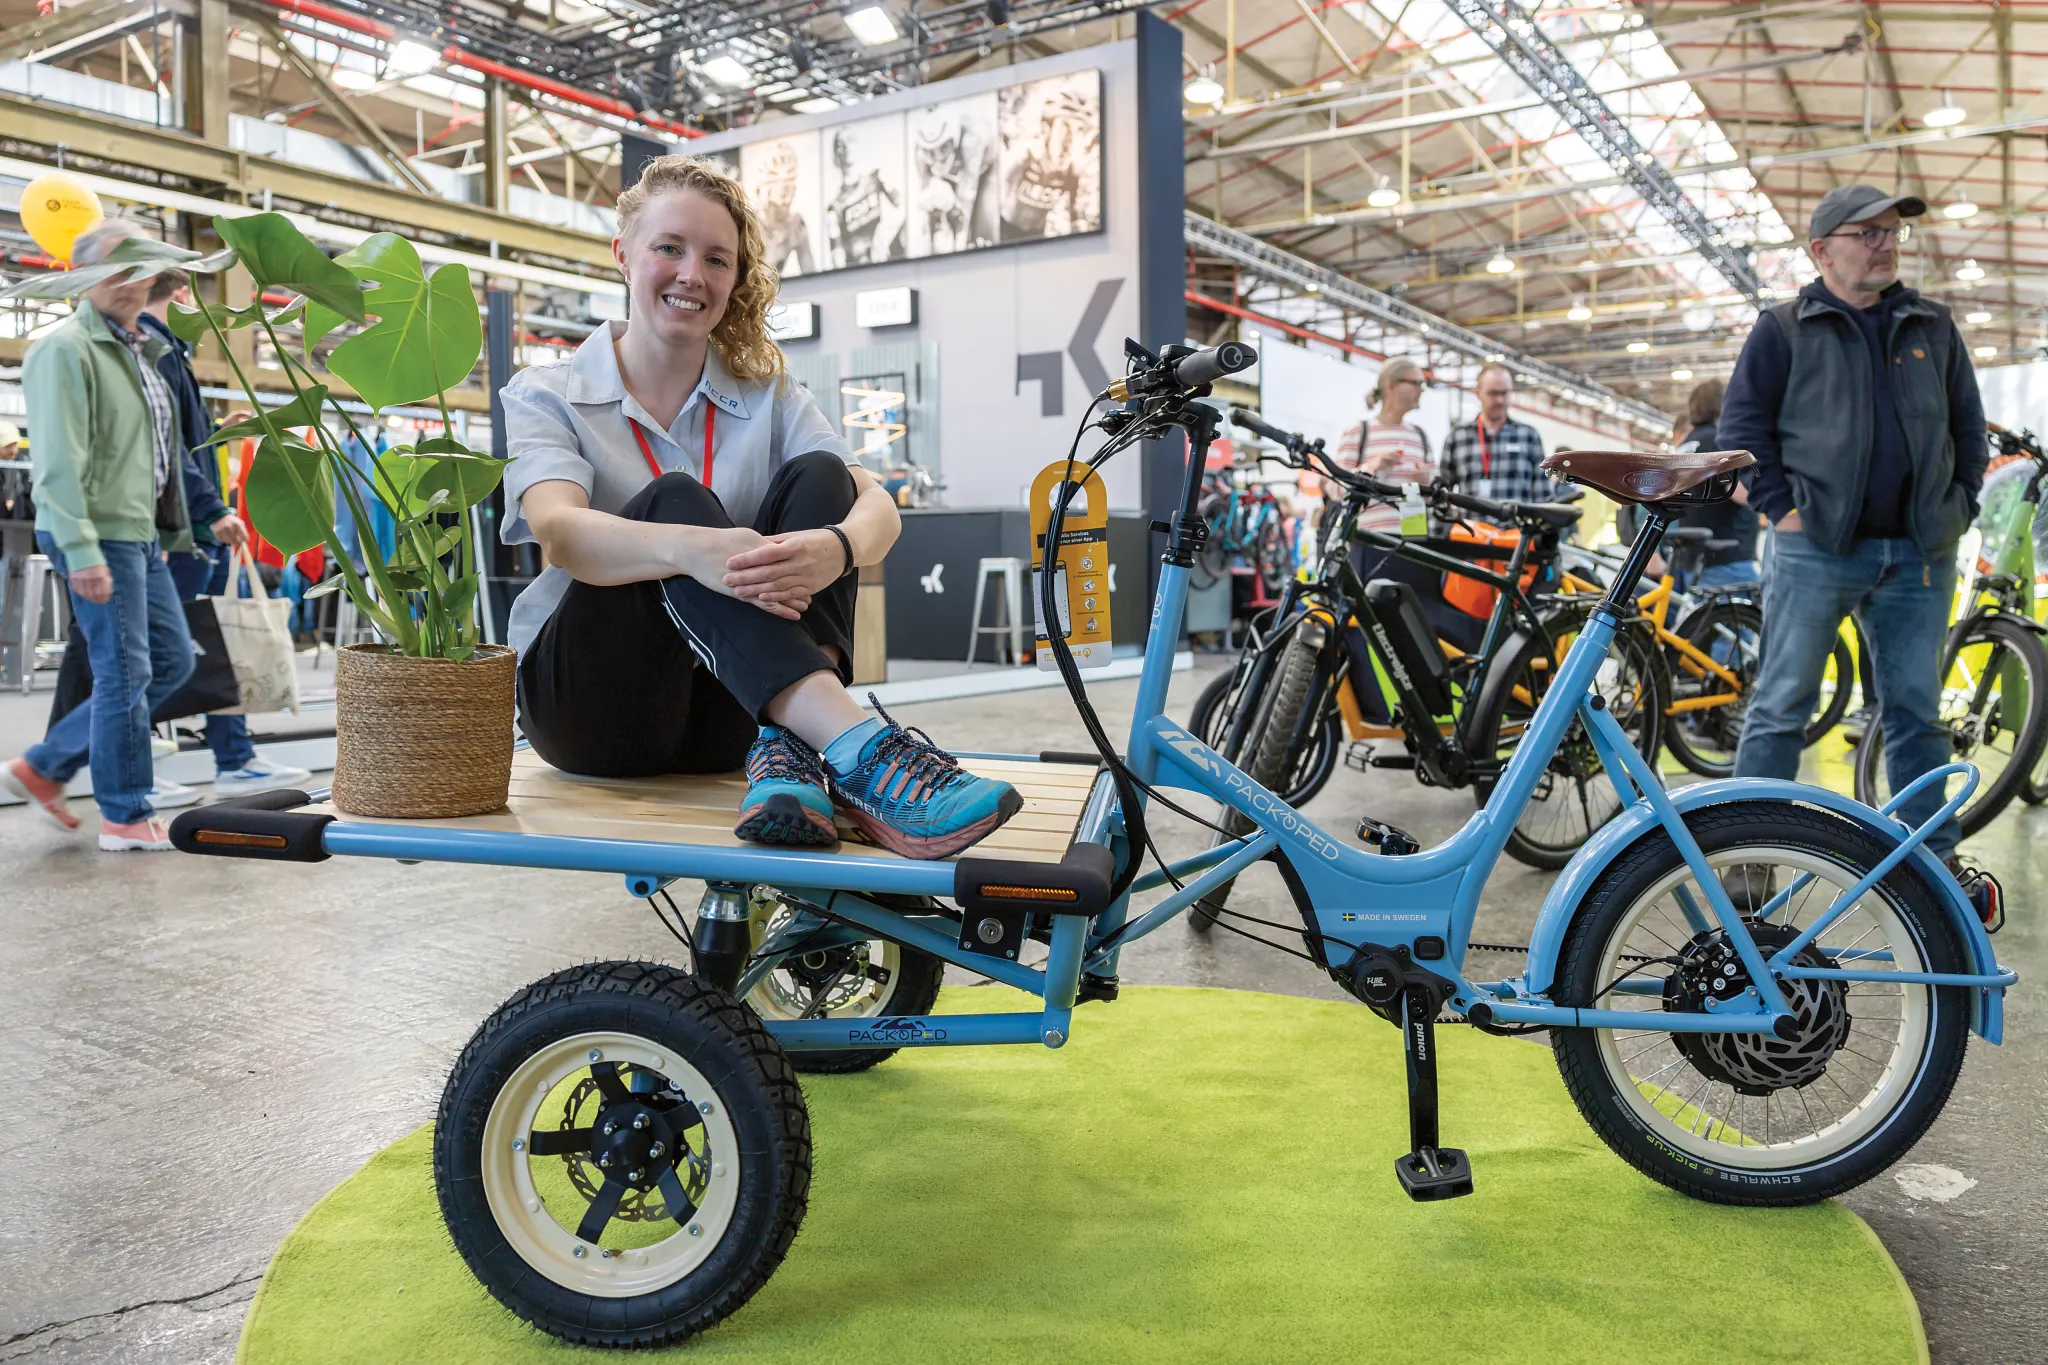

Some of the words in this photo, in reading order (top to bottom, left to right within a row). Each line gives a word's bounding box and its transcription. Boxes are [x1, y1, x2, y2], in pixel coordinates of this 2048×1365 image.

[1224, 772, 1339, 861] PACKOPED
[1357, 913, 1381, 921] MADE
[849, 1028, 948, 1041] PACKOPED
[1413, 1022, 1427, 1061] pinion
[1646, 1134, 1698, 1170] PICK-UP
[1720, 1171, 1802, 1185] SCHWALBE
